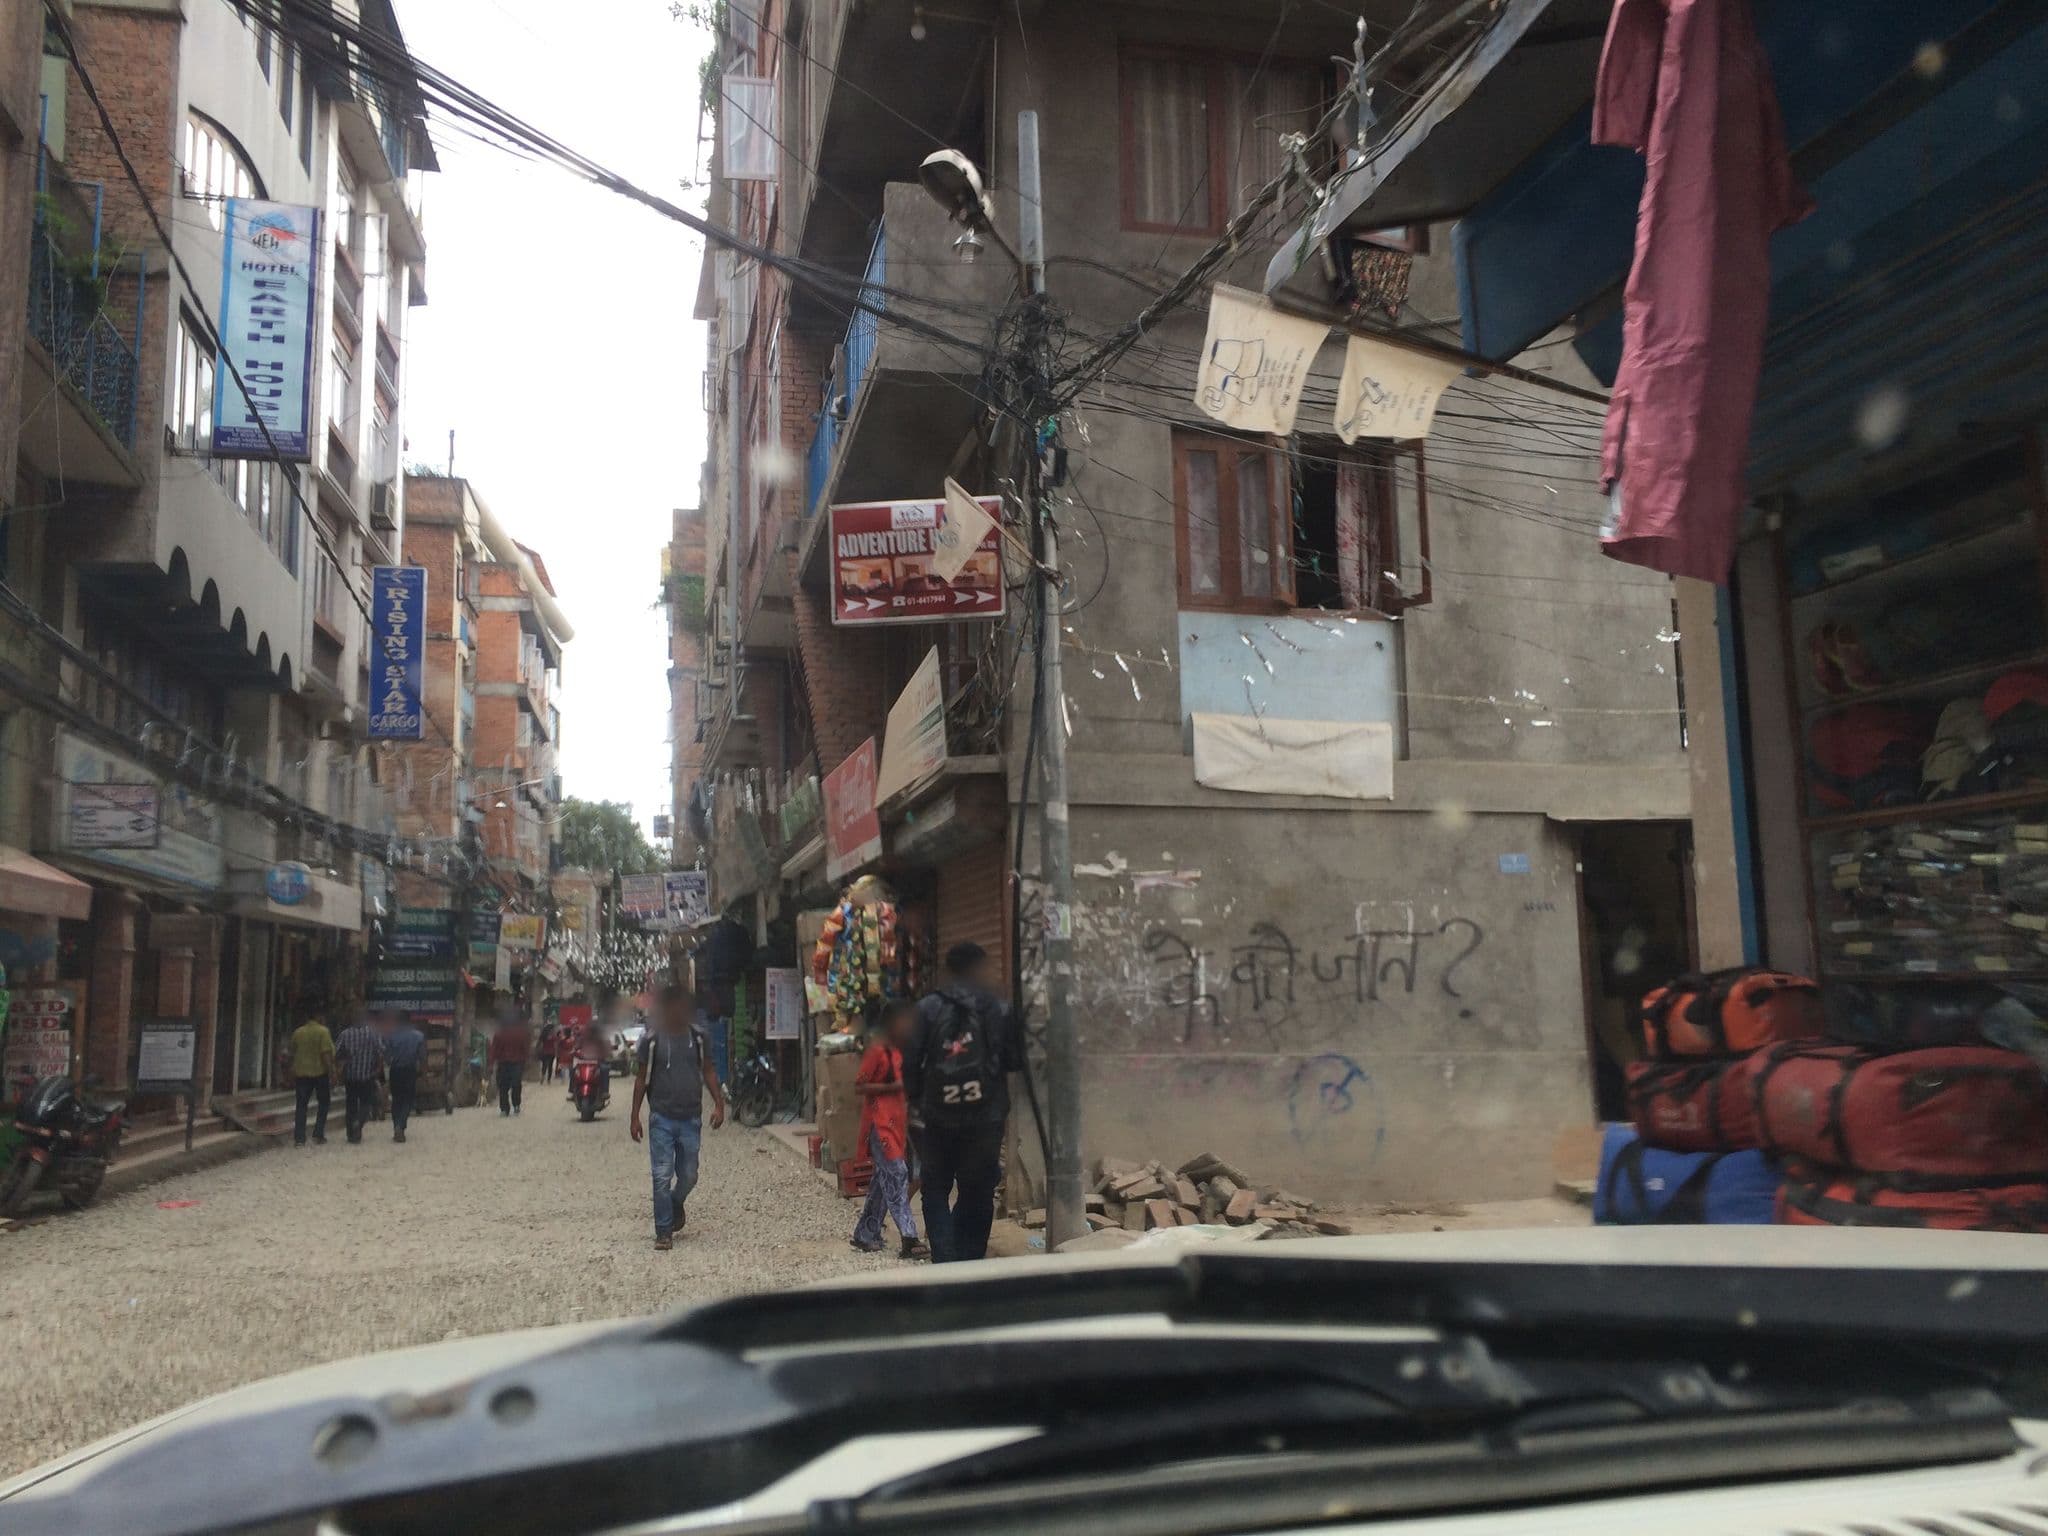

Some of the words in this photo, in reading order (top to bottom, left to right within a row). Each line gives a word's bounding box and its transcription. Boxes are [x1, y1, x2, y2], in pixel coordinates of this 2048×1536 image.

[241, 261, 297, 275] HOTEL
[248, 279, 287, 344] EARTH
[244, 359, 284, 426] HOUSE
[838, 528, 928, 558] ADVENTURE
[384, 587, 411, 659] RISING
[383, 665, 407, 713] STAR
[370, 714, 418, 728] CARGO
[943, 1080, 982, 1104] 23
